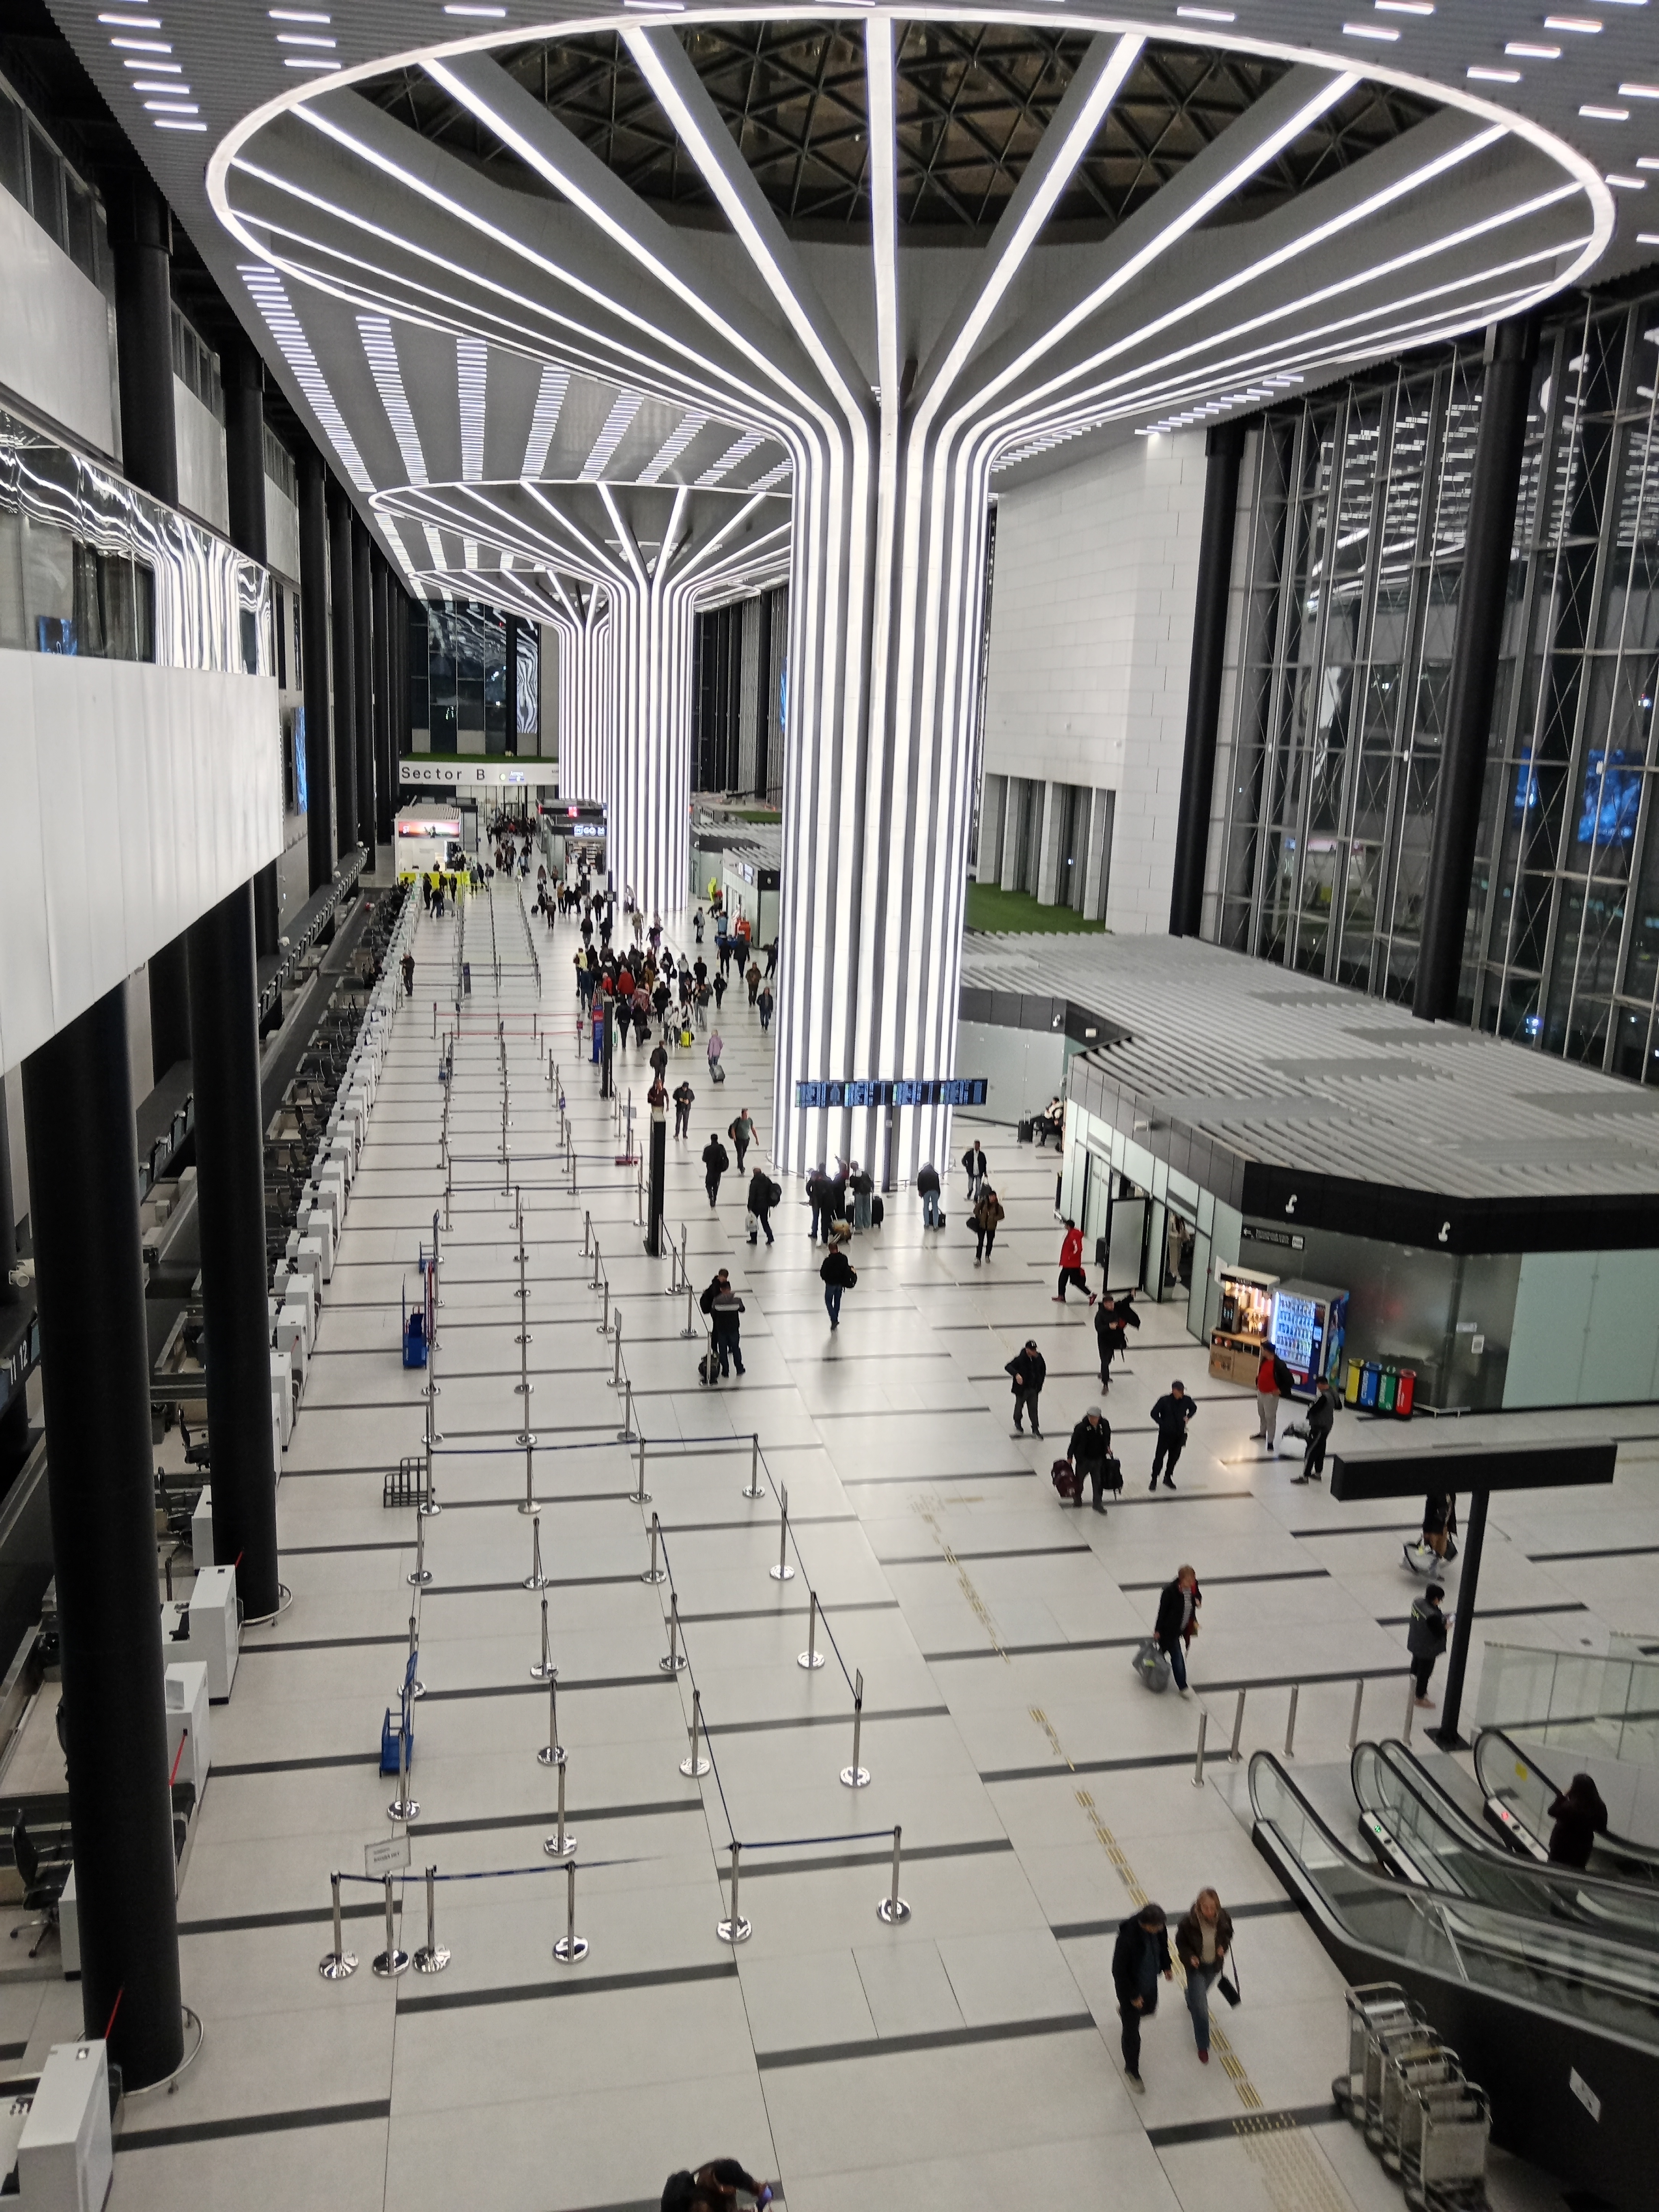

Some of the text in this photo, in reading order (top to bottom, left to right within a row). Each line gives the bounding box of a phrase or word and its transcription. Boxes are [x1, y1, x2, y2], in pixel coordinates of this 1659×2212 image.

[402, 767, 485, 780] Sector B
[583, 827, 596, 835] GO
[19, 1340, 28, 1371] 12
